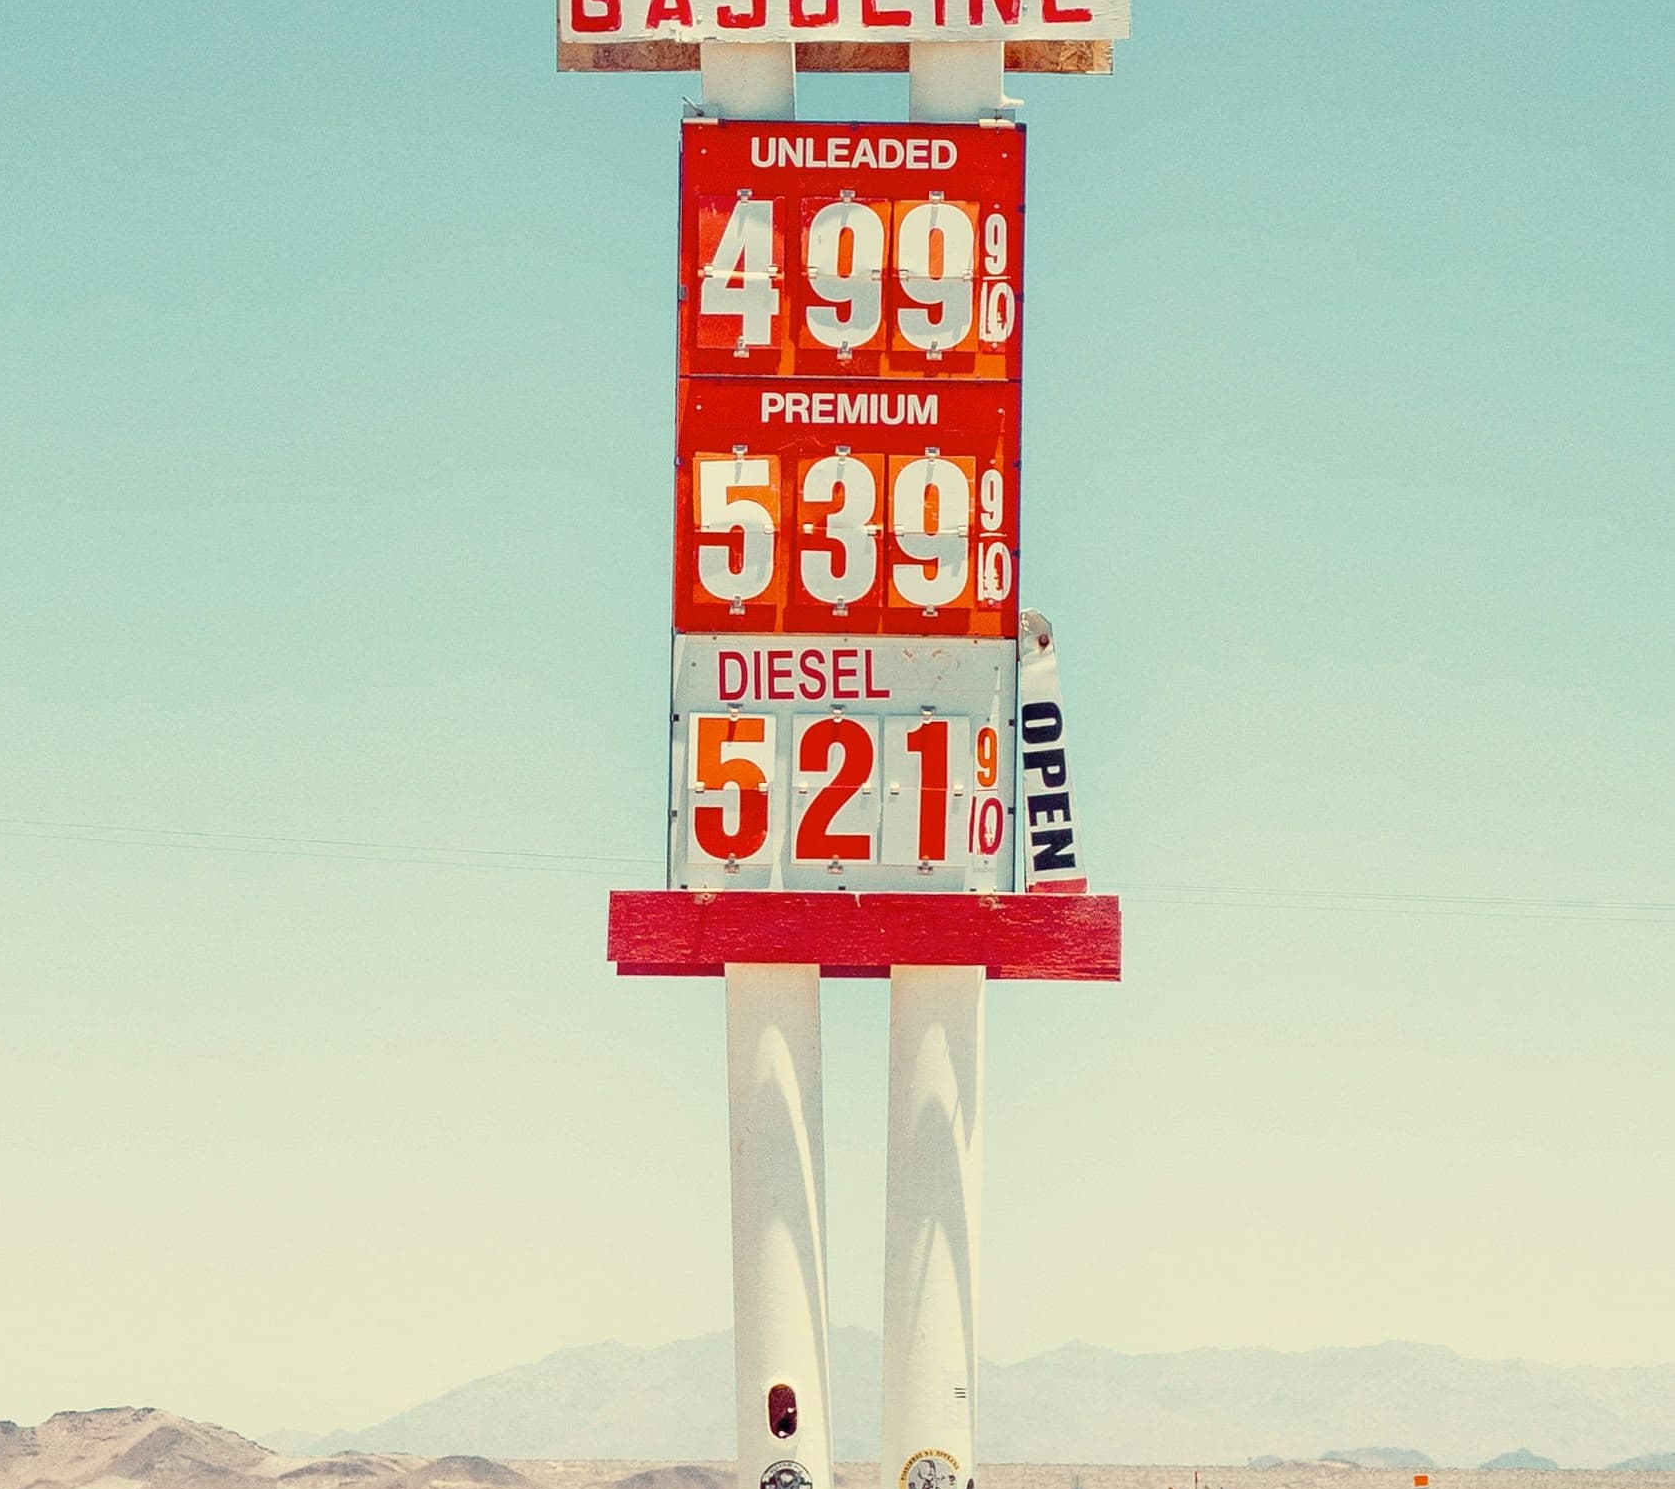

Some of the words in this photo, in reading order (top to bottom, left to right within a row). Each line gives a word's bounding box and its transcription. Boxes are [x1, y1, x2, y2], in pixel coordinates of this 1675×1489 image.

[750, 137, 958, 170] UNLEADED
[700, 199, 974, 351] 499
[761, 392, 939, 425] PREMIUM
[697, 455, 970, 607] 539
[718, 649, 891, 701] DIESEL
[693, 717, 948, 862] 521
[1021, 701, 1077, 872] OPEN
